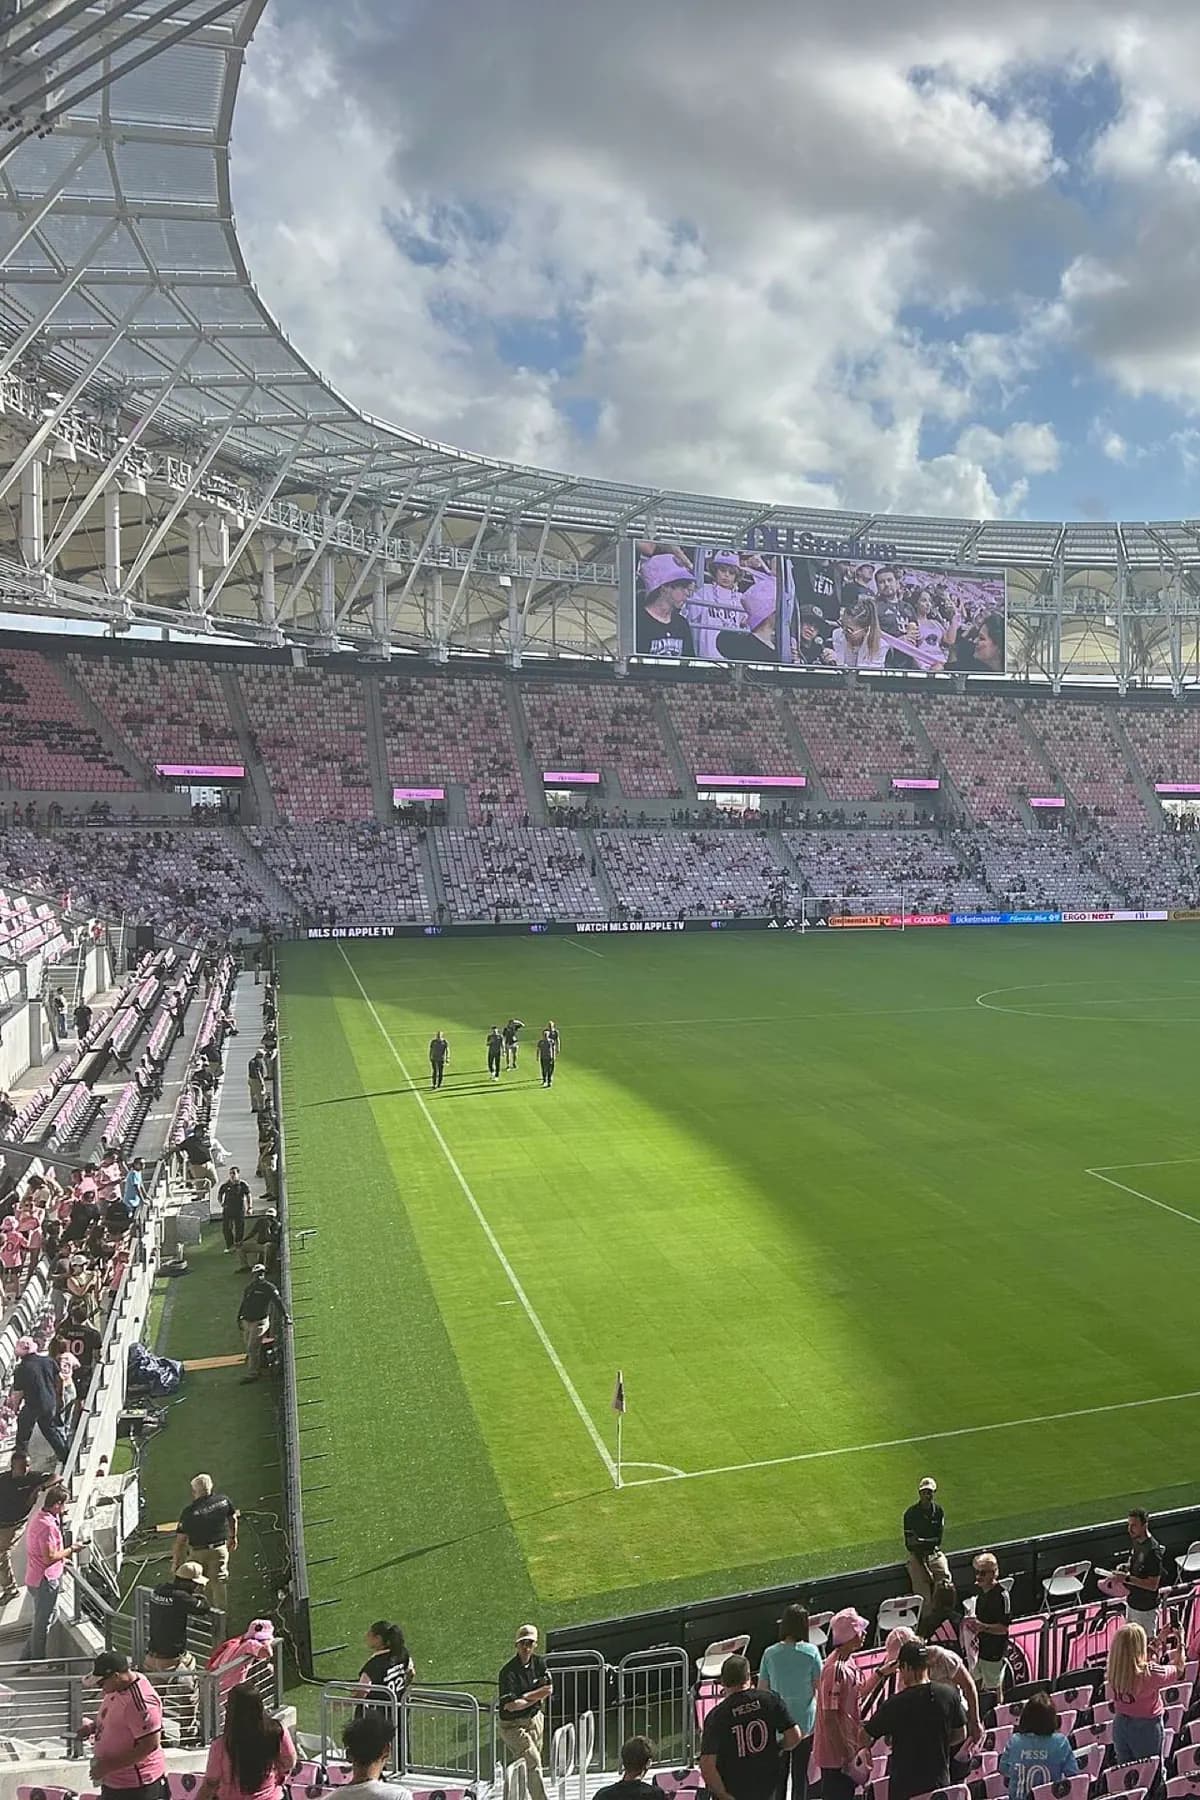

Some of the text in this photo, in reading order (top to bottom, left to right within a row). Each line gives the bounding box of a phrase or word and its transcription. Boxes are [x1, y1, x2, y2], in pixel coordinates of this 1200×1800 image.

[800, 530, 897, 561] Stadium
[955, 914, 1001, 924] ticketmaster
[1063, 913, 1087, 921] ERGO
[308, 926, 395, 938] MLS ON APPLE TV
[576, 920, 685, 932] WATCH MLS ON APPLE TV
[731, 1700, 761, 1718] MESSI
[730, 1718, 769, 1758] 10
[1020, 1749, 1049, 1761] MESSI
[1015, 1763, 1051, 1800] 10
